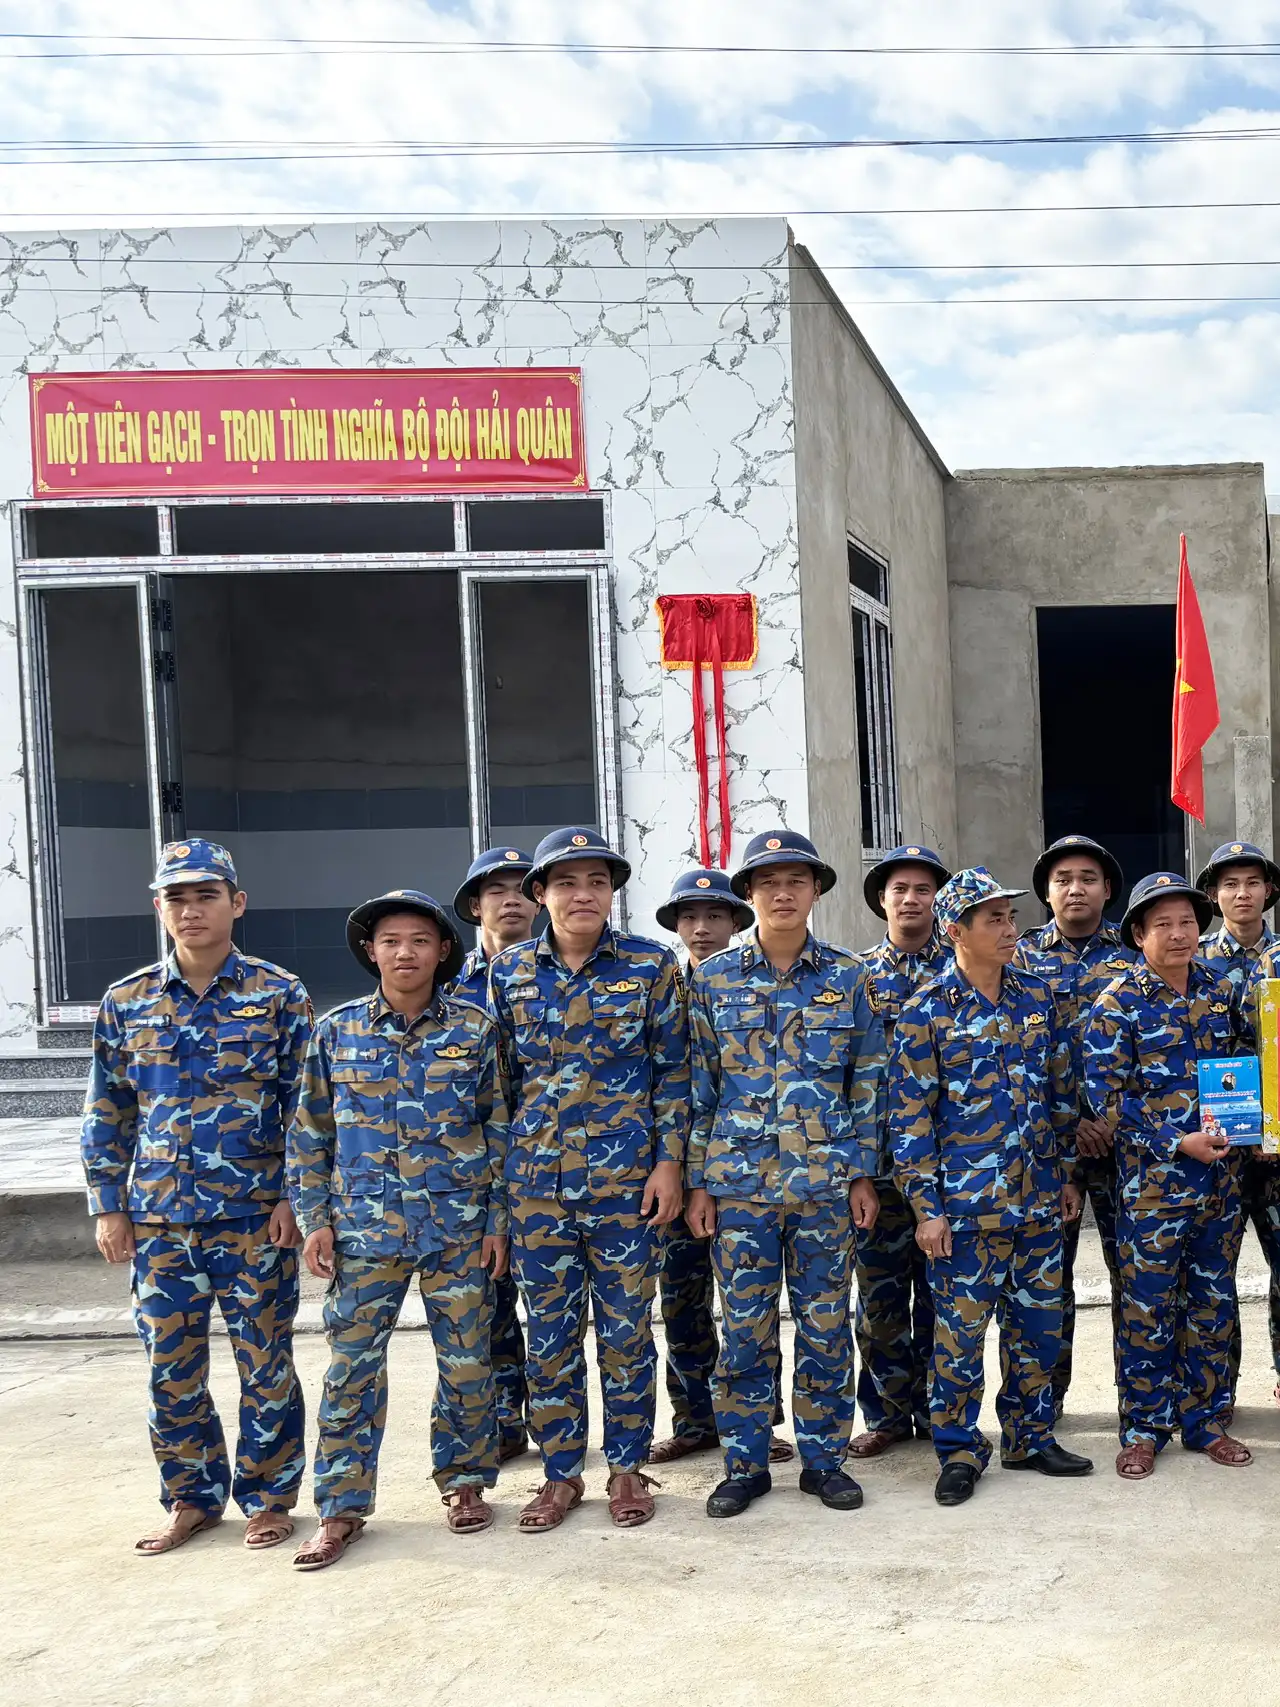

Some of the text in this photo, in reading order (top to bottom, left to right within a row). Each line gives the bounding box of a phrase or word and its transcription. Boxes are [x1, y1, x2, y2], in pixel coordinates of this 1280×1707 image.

[46, 401, 89, 476] MỘT
[94, 400, 142, 464] VIÊN
[147, 410, 203, 474] GẠCH
[220, 409, 276, 473] TRỌN
[280, 397, 328, 461] TÌNH
[333, 399, 399, 461] NGHĨA
[402, 397, 430, 472] BỘ
[434, 397, 471, 472] ĐỘI
[476, 389, 511, 460] HẢI
[516, 396, 573, 466] QUÂN
